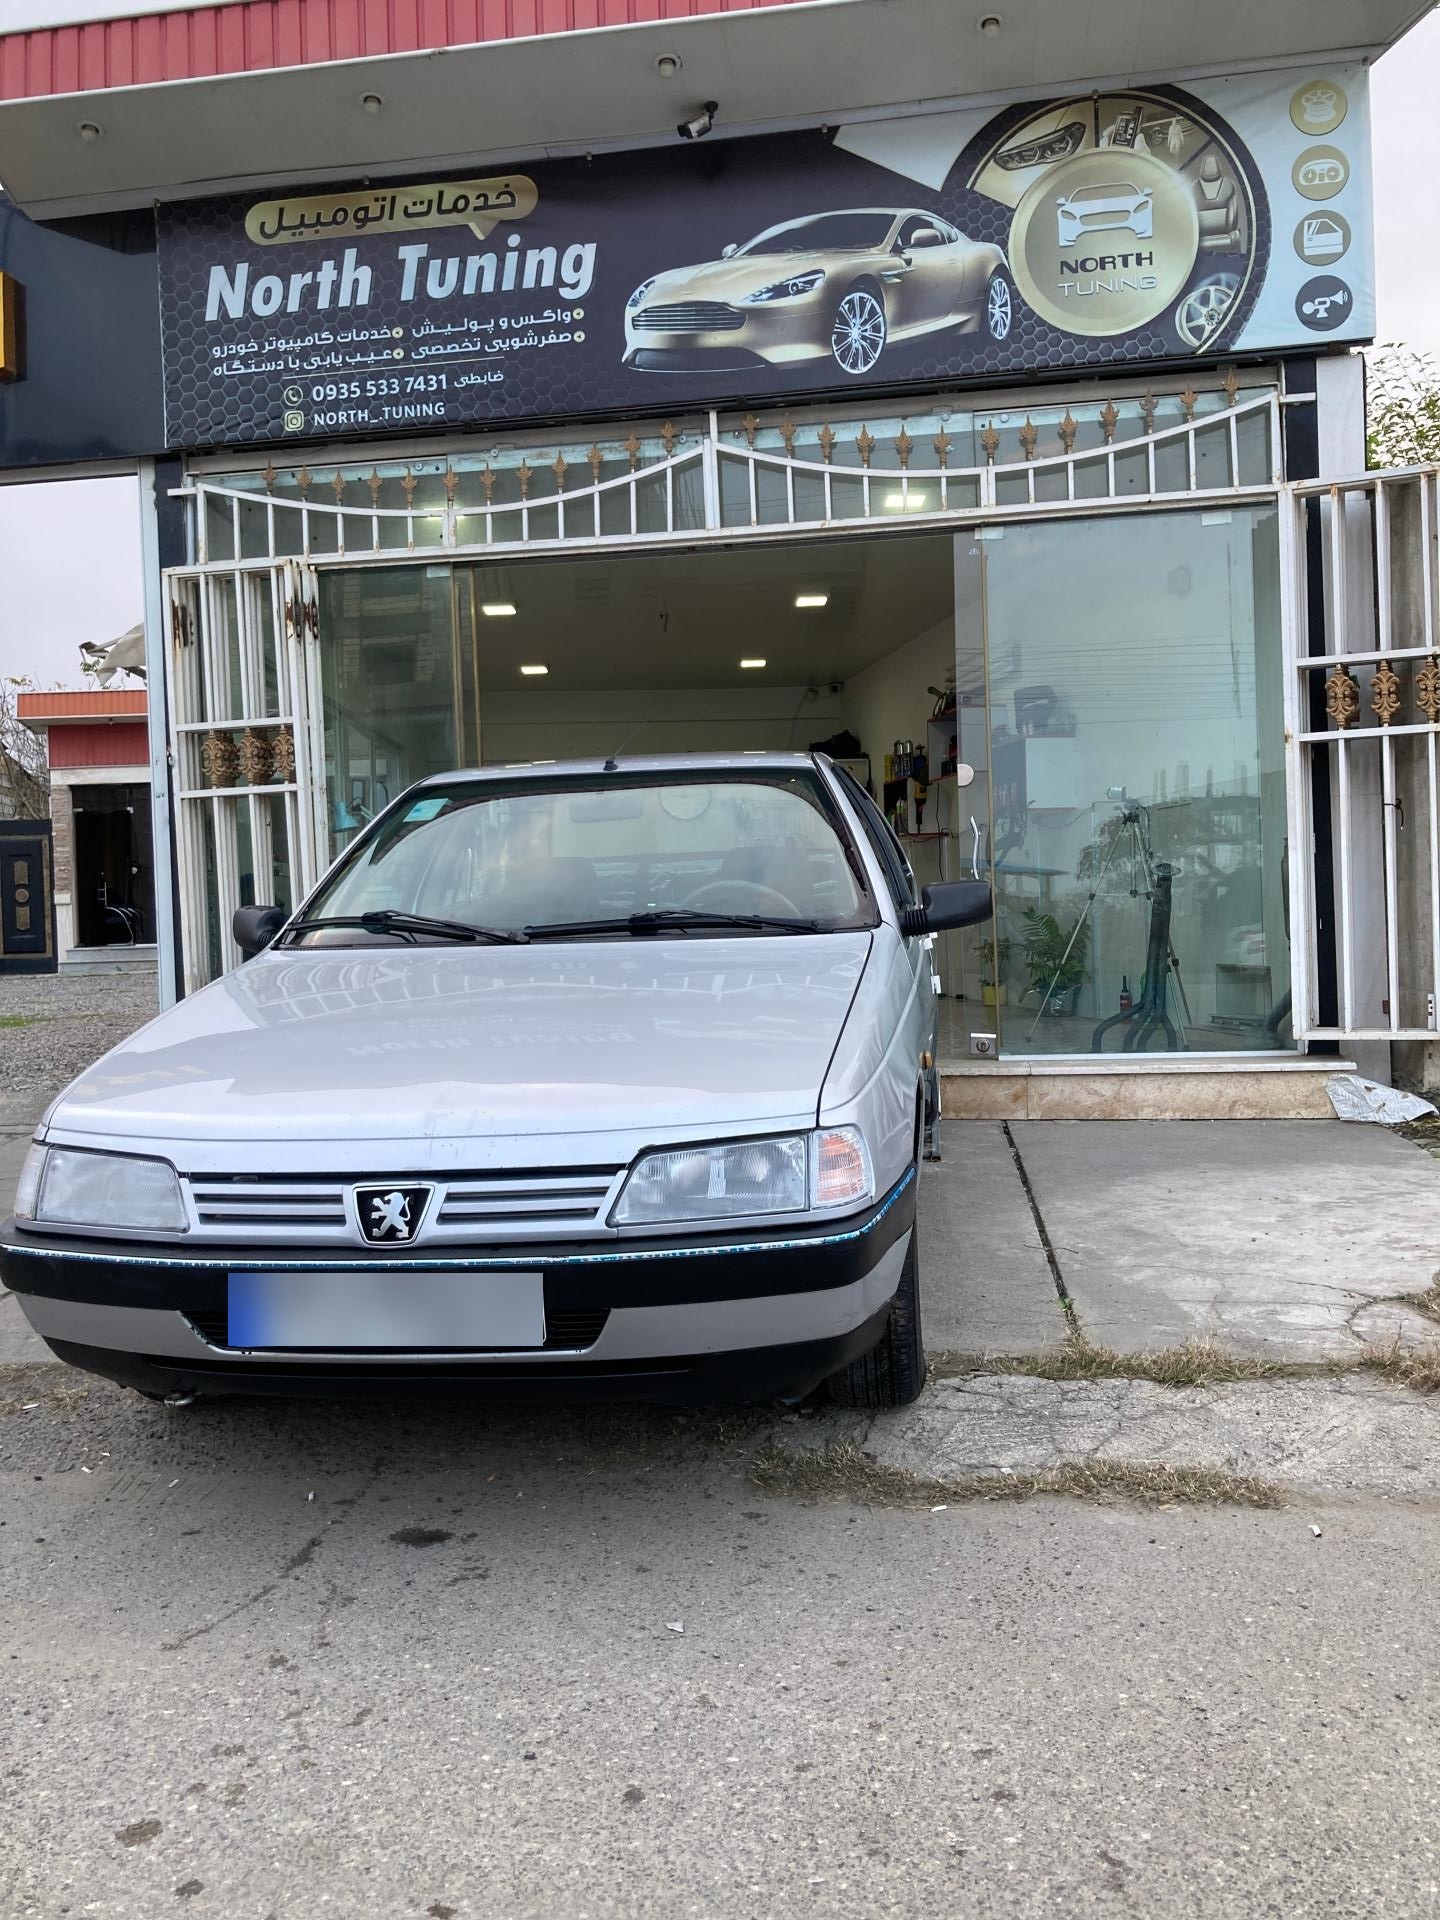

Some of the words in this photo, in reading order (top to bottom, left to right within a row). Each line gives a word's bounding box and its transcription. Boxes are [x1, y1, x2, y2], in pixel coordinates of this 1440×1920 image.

[403, 183, 517, 218] خدمات
[259, 195, 397, 240] اتومبیل
[1060, 251, 1153, 275] NORTH
[205, 247, 373, 321] North
[399, 233, 598, 300] Tuning
[1058, 275, 1157, 297] TUNING
[337, 325, 392, 344] خدمات
[498, 317, 509, 330] و
[212, 339, 258, 358] خودرو
[262, 331, 334, 354] کامپیوتر
[411, 337, 481, 359] تخصصی
[485, 329, 572, 353] صفرشویی
[213, 360, 285, 376] دستگاه
[288, 356, 300, 371] با
[312, 382, 361, 401] 0935
[366, 378, 400, 397] 533
[404, 374, 447, 393] 7431
